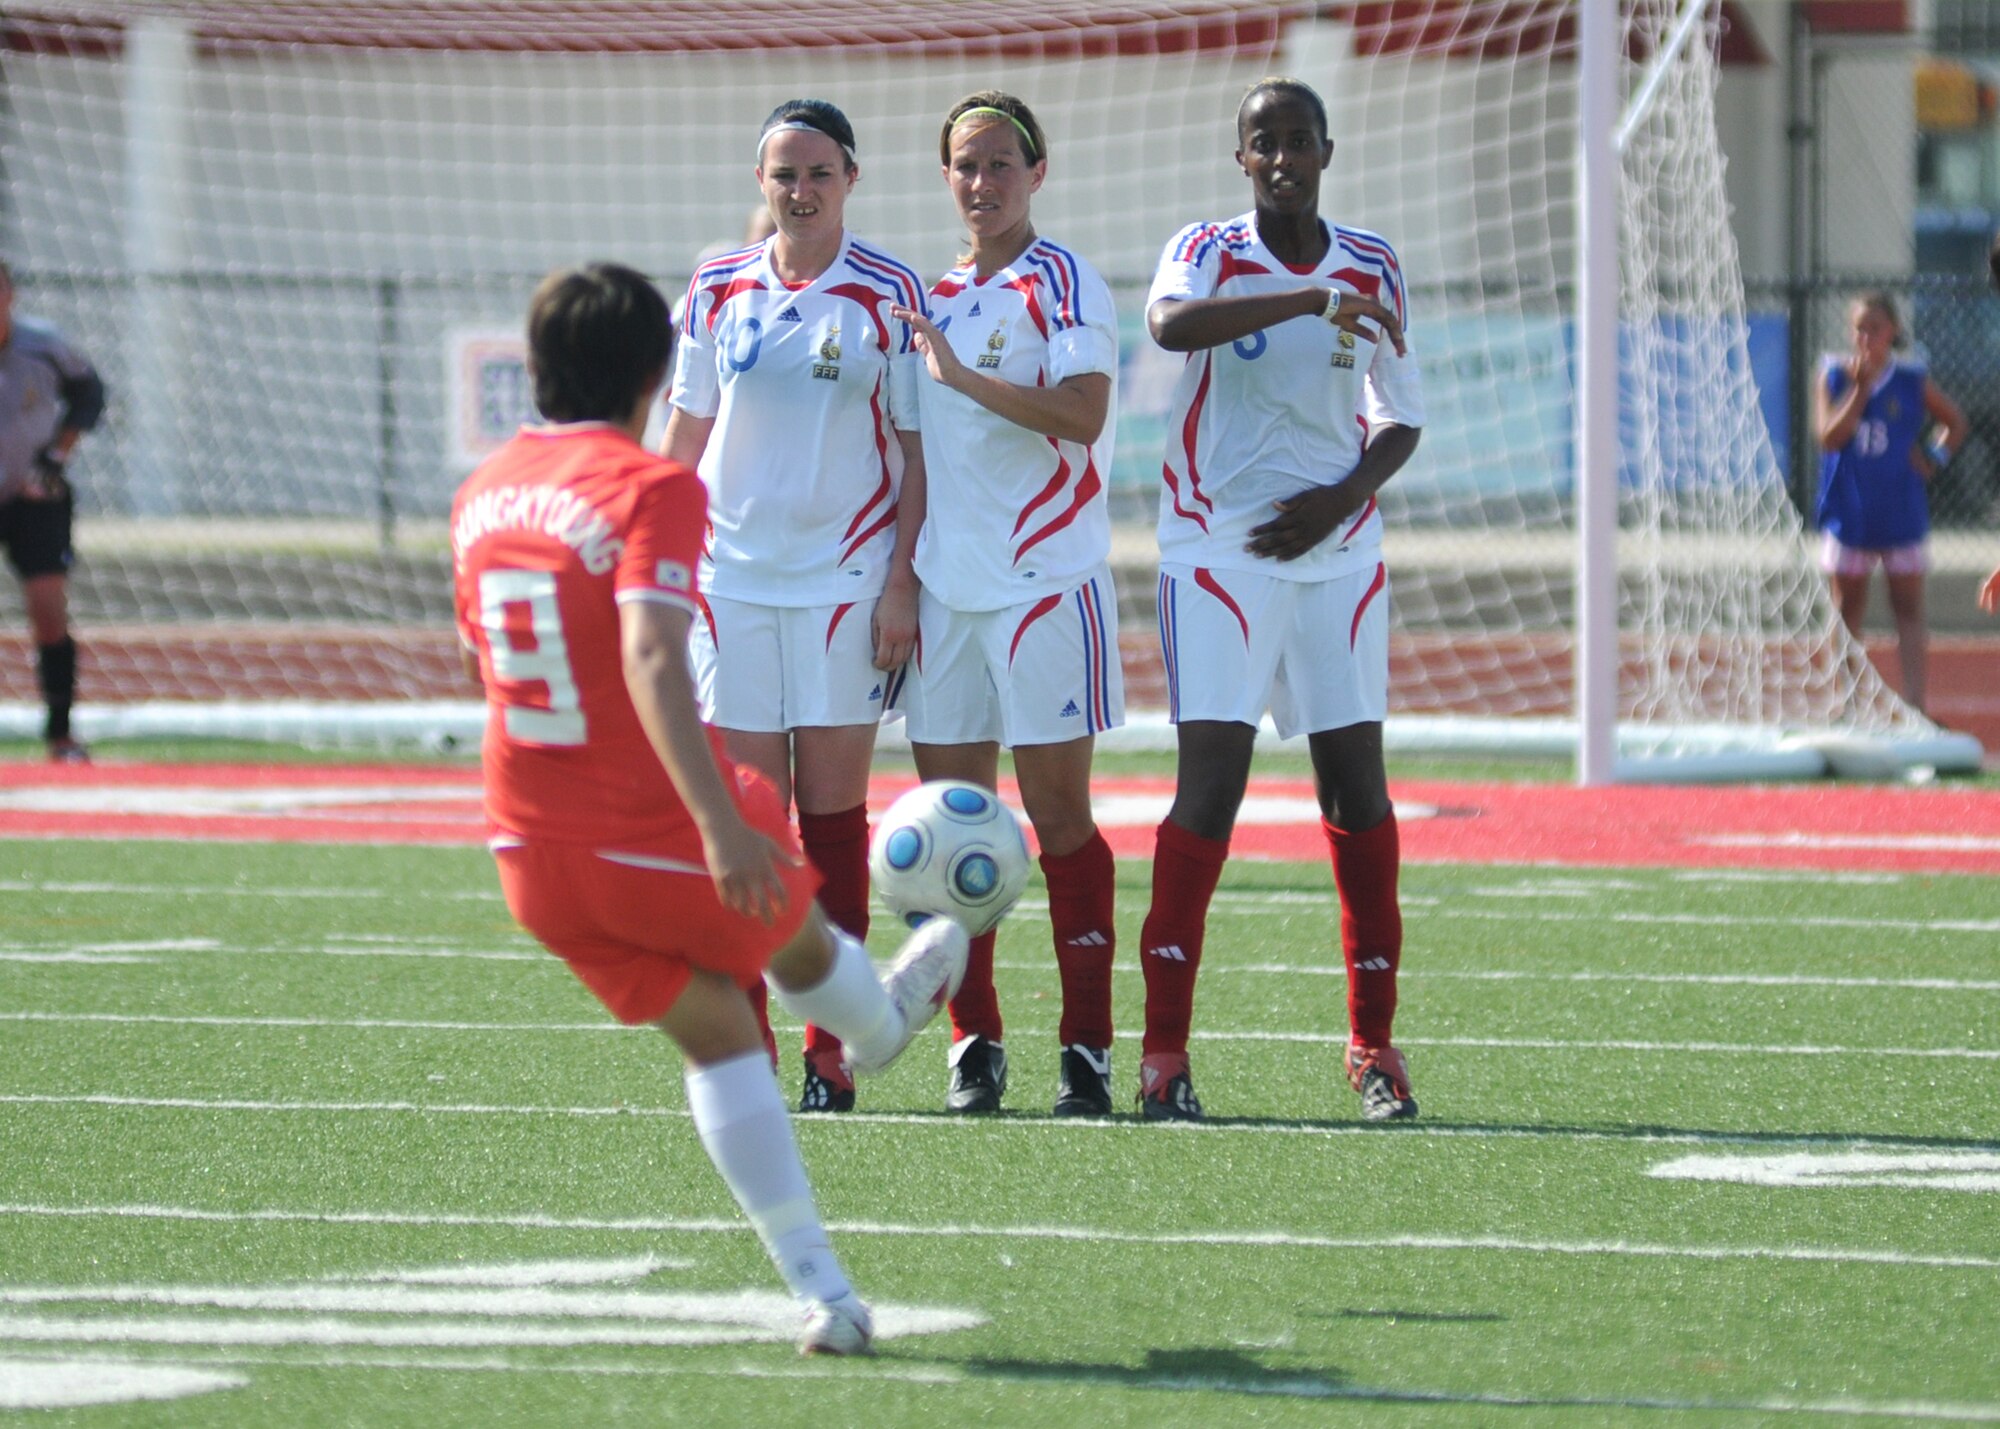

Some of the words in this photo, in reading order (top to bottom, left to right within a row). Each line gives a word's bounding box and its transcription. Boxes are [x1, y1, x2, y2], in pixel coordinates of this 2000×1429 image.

[977, 355, 1000, 368] FFF
[1332, 354, 1355, 368] FFF
[813, 365, 839, 379] FFF
[478, 569, 589, 746] 9
